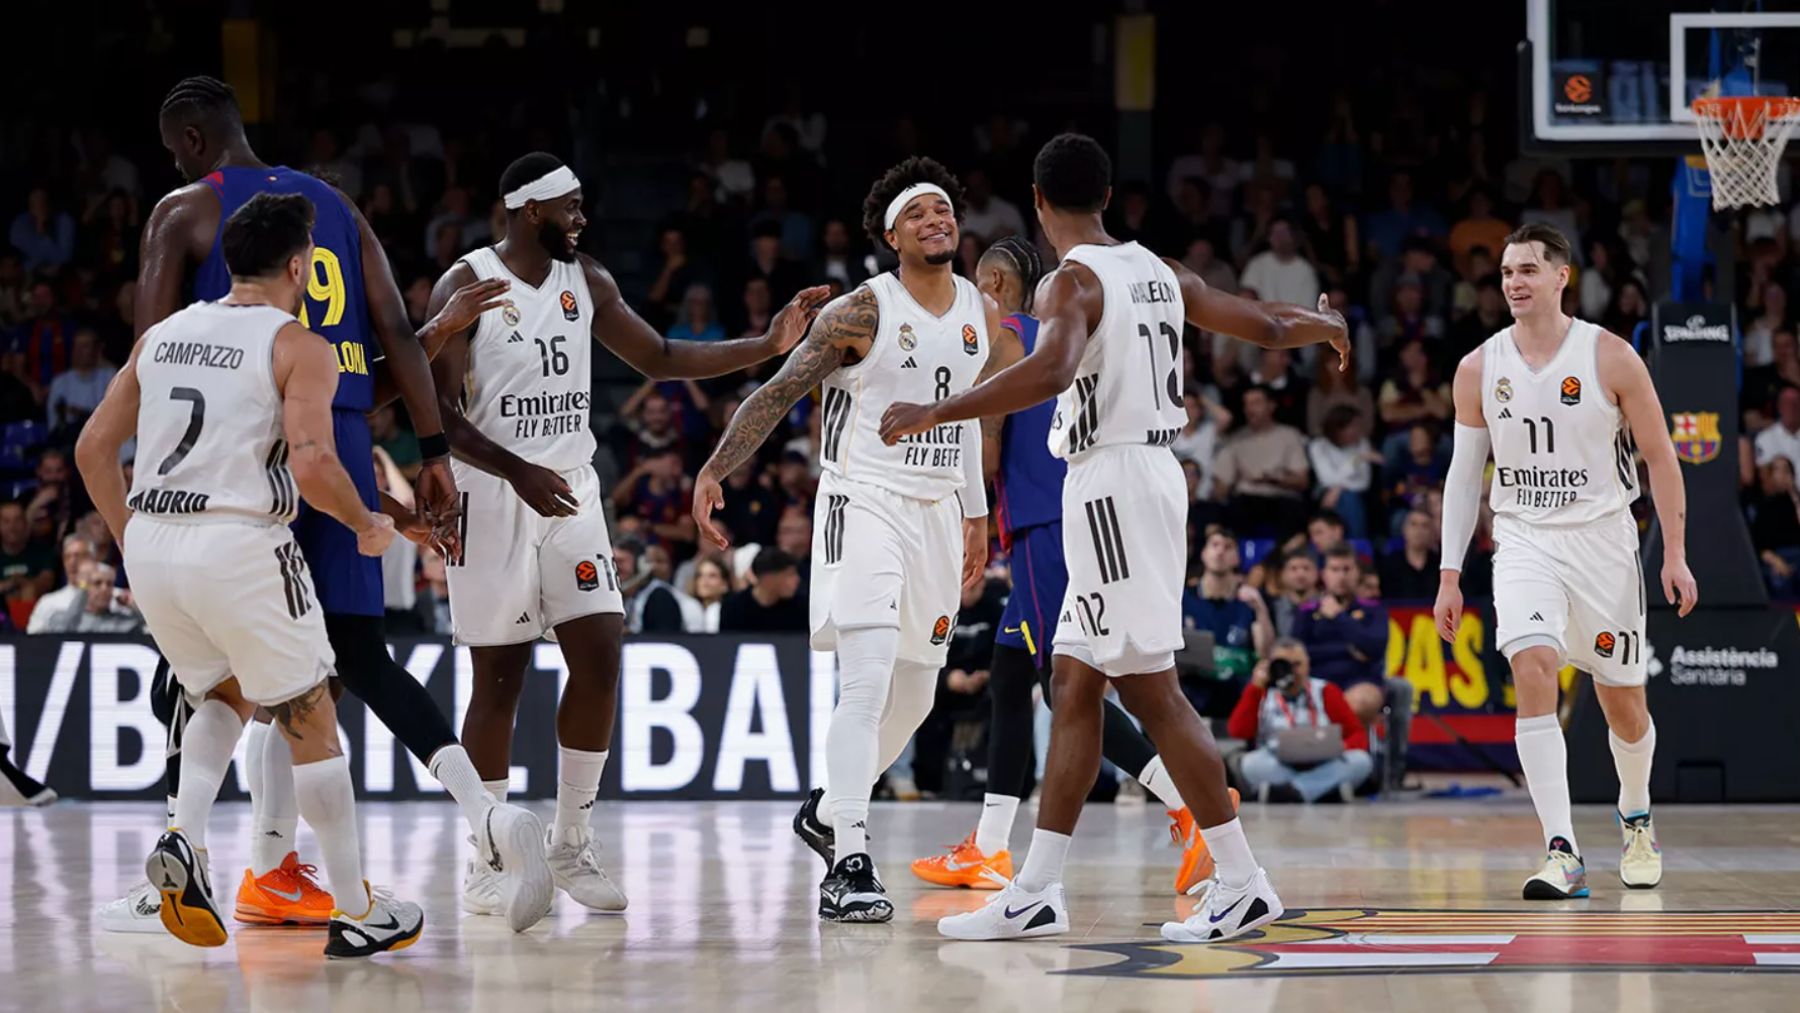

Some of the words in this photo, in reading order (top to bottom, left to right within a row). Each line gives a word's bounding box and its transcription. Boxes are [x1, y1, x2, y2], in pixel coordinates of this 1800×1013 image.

[299, 246, 346, 329] 9
[154, 342, 244, 370] CAMPAZZO
[534, 335, 569, 377] 16
[934, 366, 951, 401] 8
[157, 386, 205, 476] 7
[515, 419, 539, 438] FLY
[1523, 416, 1554, 454] 11
[904, 446, 929, 466] FLY
[1498, 465, 1588, 487] Emirates
[1516, 488, 1532, 506] FLY
[1534, 490, 1577, 508] BETTER
[1076, 591, 1110, 637] 12
[1619, 630, 1640, 665] 11
